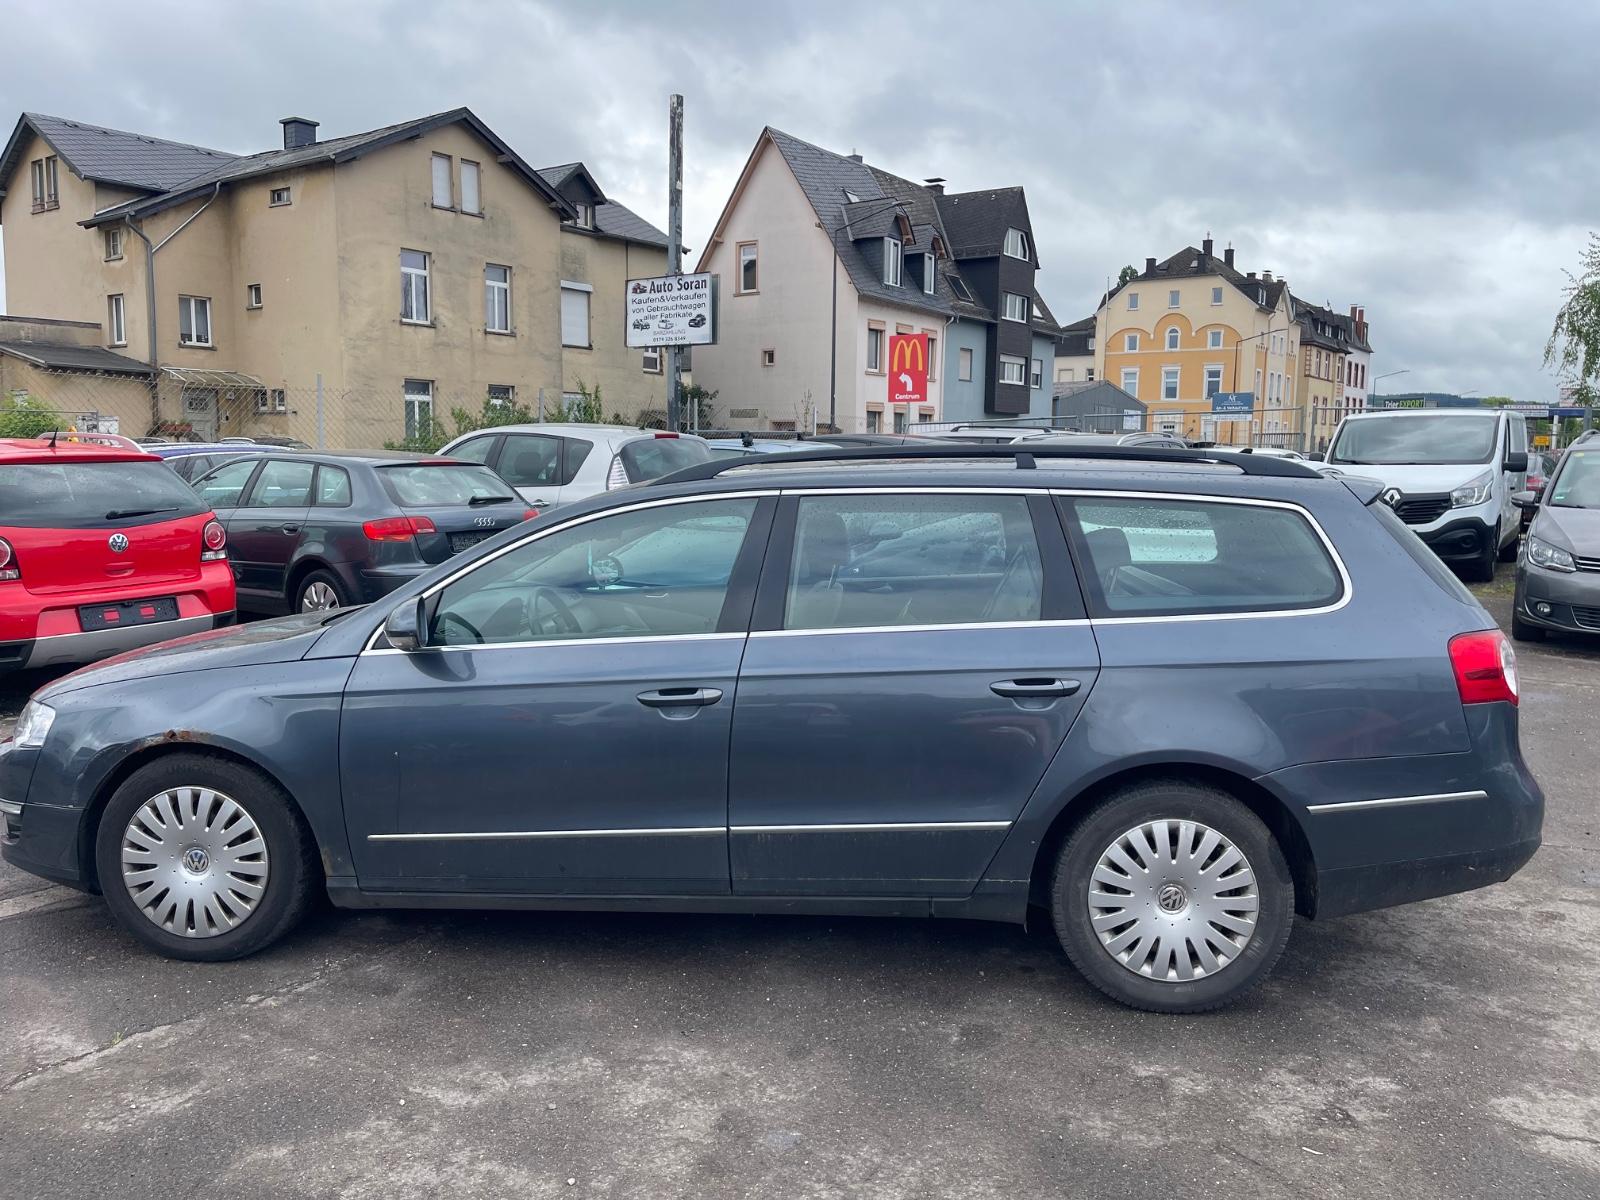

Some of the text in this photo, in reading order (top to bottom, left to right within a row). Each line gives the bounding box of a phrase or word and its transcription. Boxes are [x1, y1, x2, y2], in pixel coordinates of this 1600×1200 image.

[649, 278, 707, 294] Auto Soran
[631, 292, 707, 305] Kaufen&Verkaufen
[647, 302, 706, 313] Gebrauchtwagen
[660, 311, 693, 319] Fabrikate
[1400, 400, 1424, 408] EXPORT
